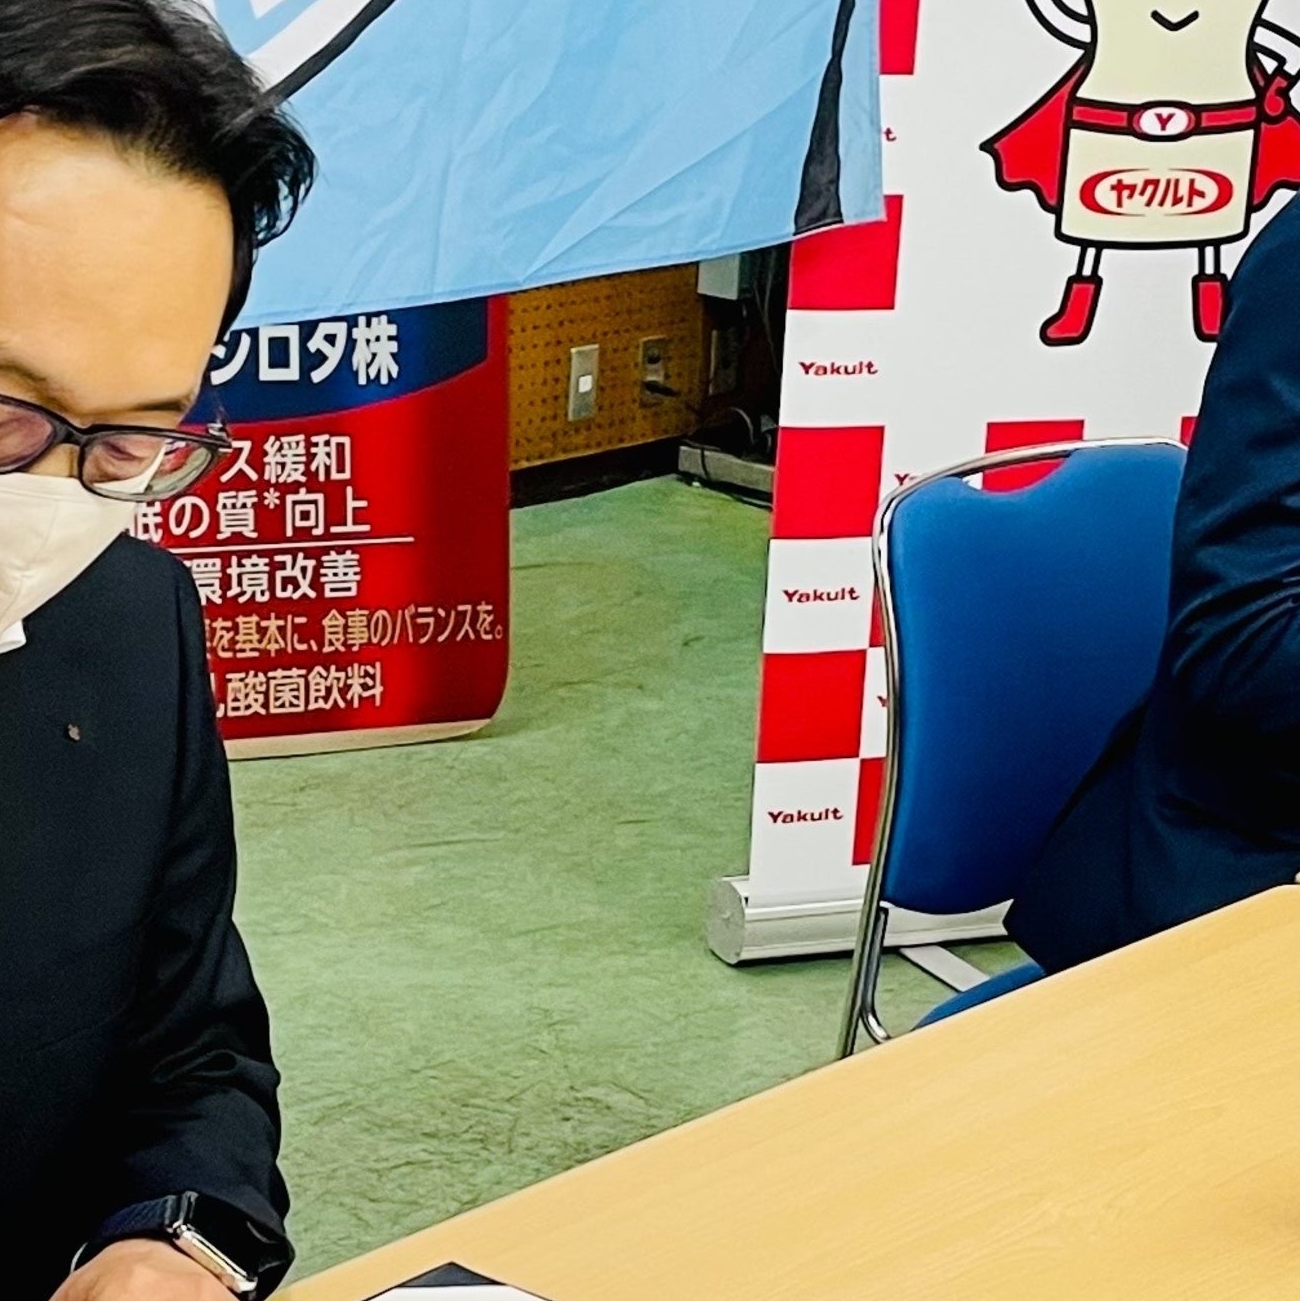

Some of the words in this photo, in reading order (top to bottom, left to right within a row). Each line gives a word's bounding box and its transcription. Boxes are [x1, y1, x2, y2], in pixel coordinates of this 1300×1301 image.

[1154, 112, 1175, 132] Y
[1109, 177, 1207, 209] ヤクルト
[799, 360, 879, 376] Yakult
[782, 586, 861, 603] Yakult
[204, 601, 504, 660] を基本に、食事のバランスを。
[767, 806, 844, 824] Yakult
